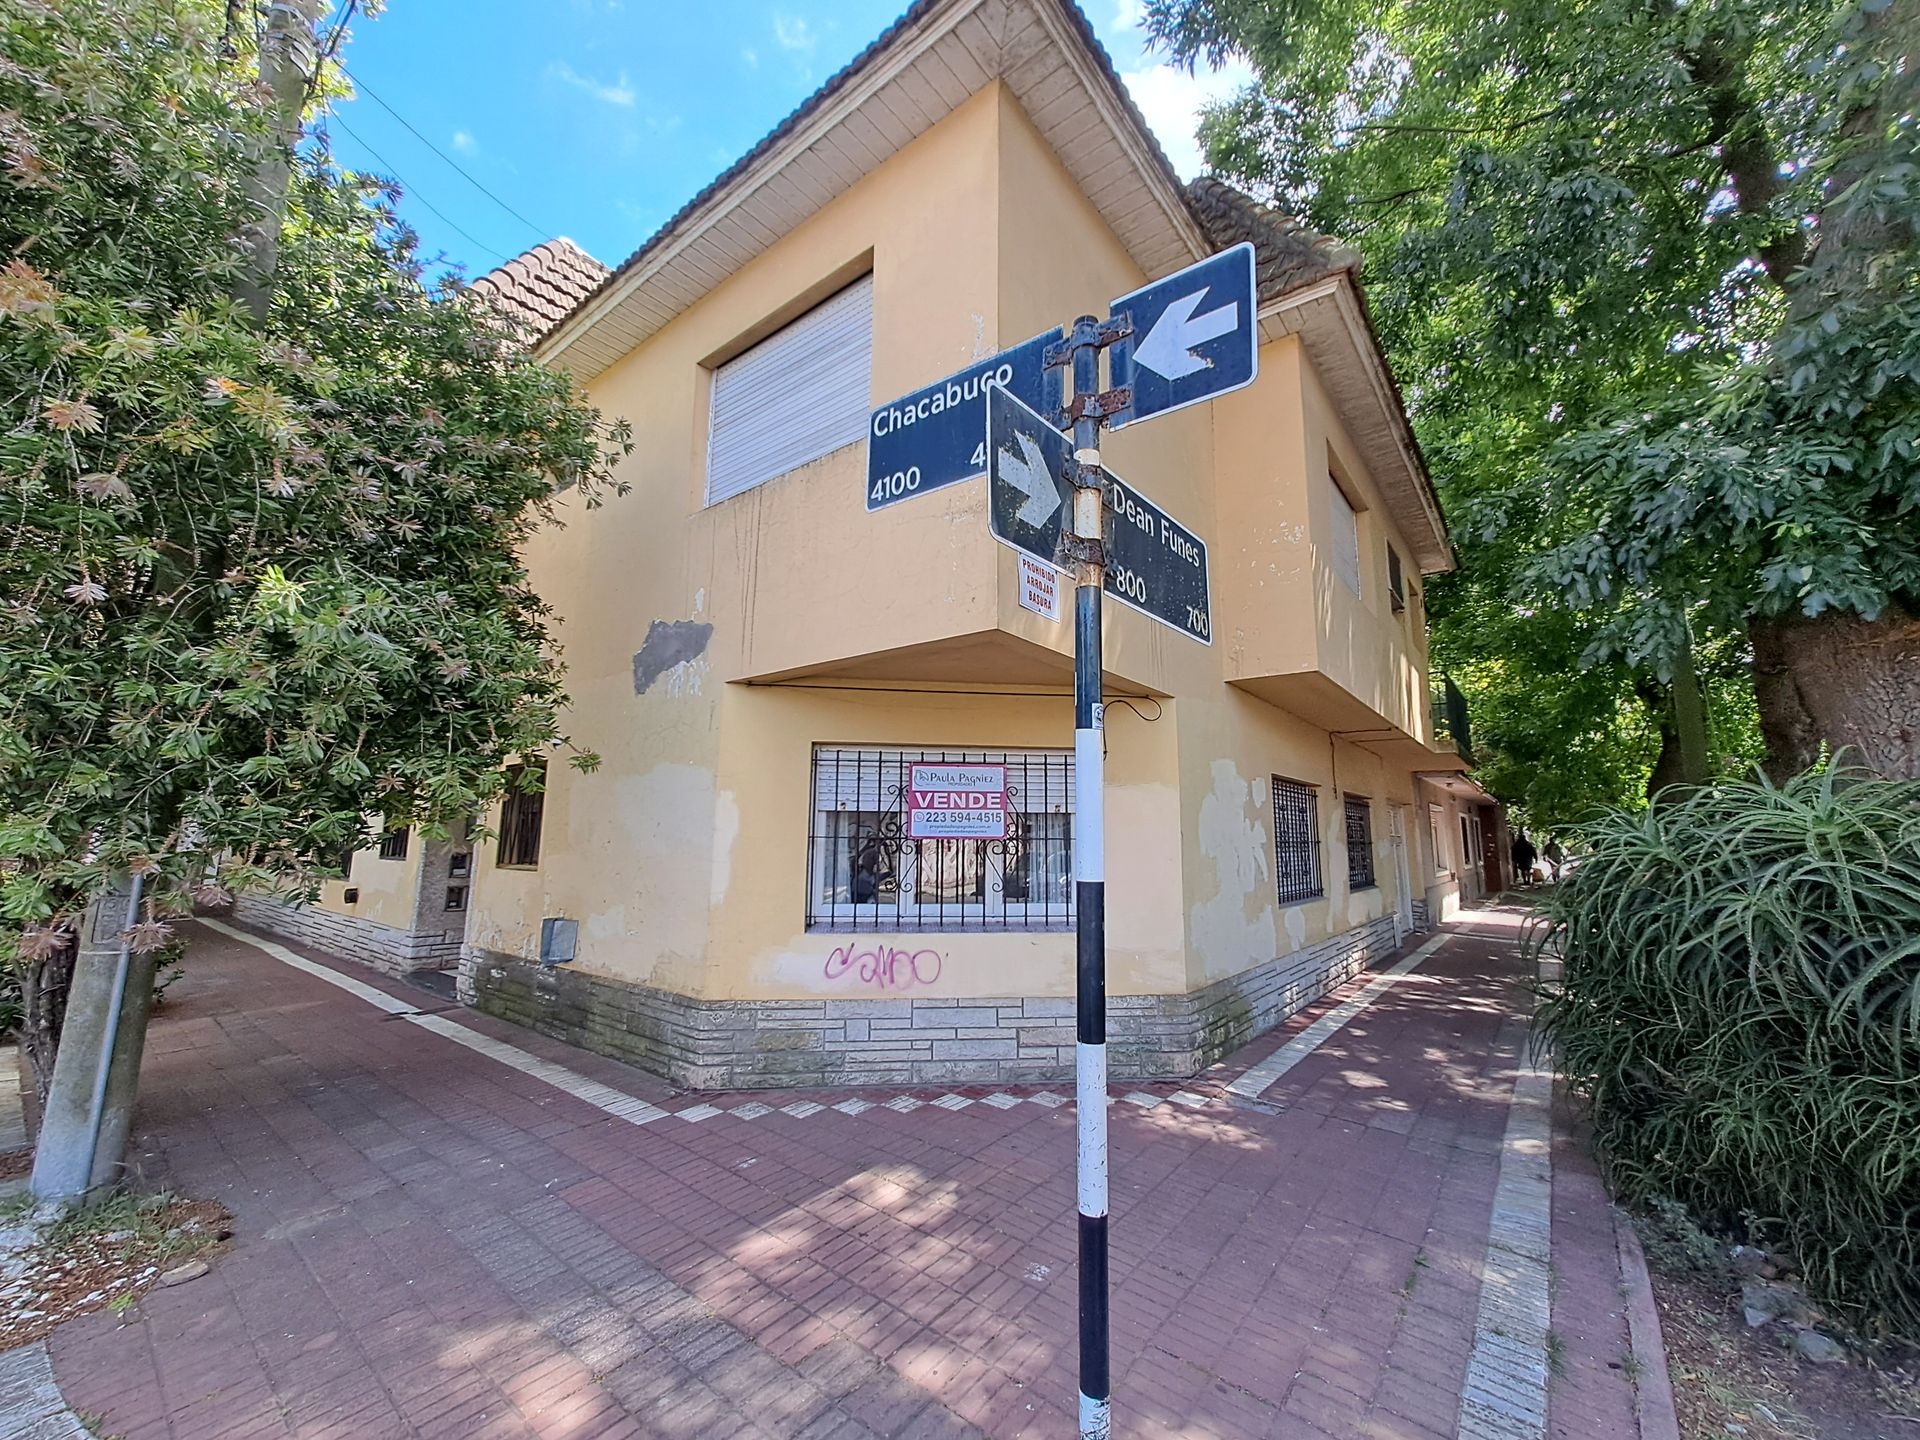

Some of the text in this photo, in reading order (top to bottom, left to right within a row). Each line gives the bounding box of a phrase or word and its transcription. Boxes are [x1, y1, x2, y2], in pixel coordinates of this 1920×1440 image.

[873, 363, 1013, 437] Chacabuco
[870, 466, 921, 501] 4100
[1113, 483, 1200, 568] Dean Funes
[1022, 558, 1056, 584] PROHIBIDO
[1026, 574, 1054, 597] ARROJAR
[1116, 566, 1147, 604] 800
[1028, 590, 1052, 611] BASURA
[1186, 605, 1209, 637] 700
[915, 792, 1001, 809] VENDE
[926, 811, 1002, 823] 223 594-4515
